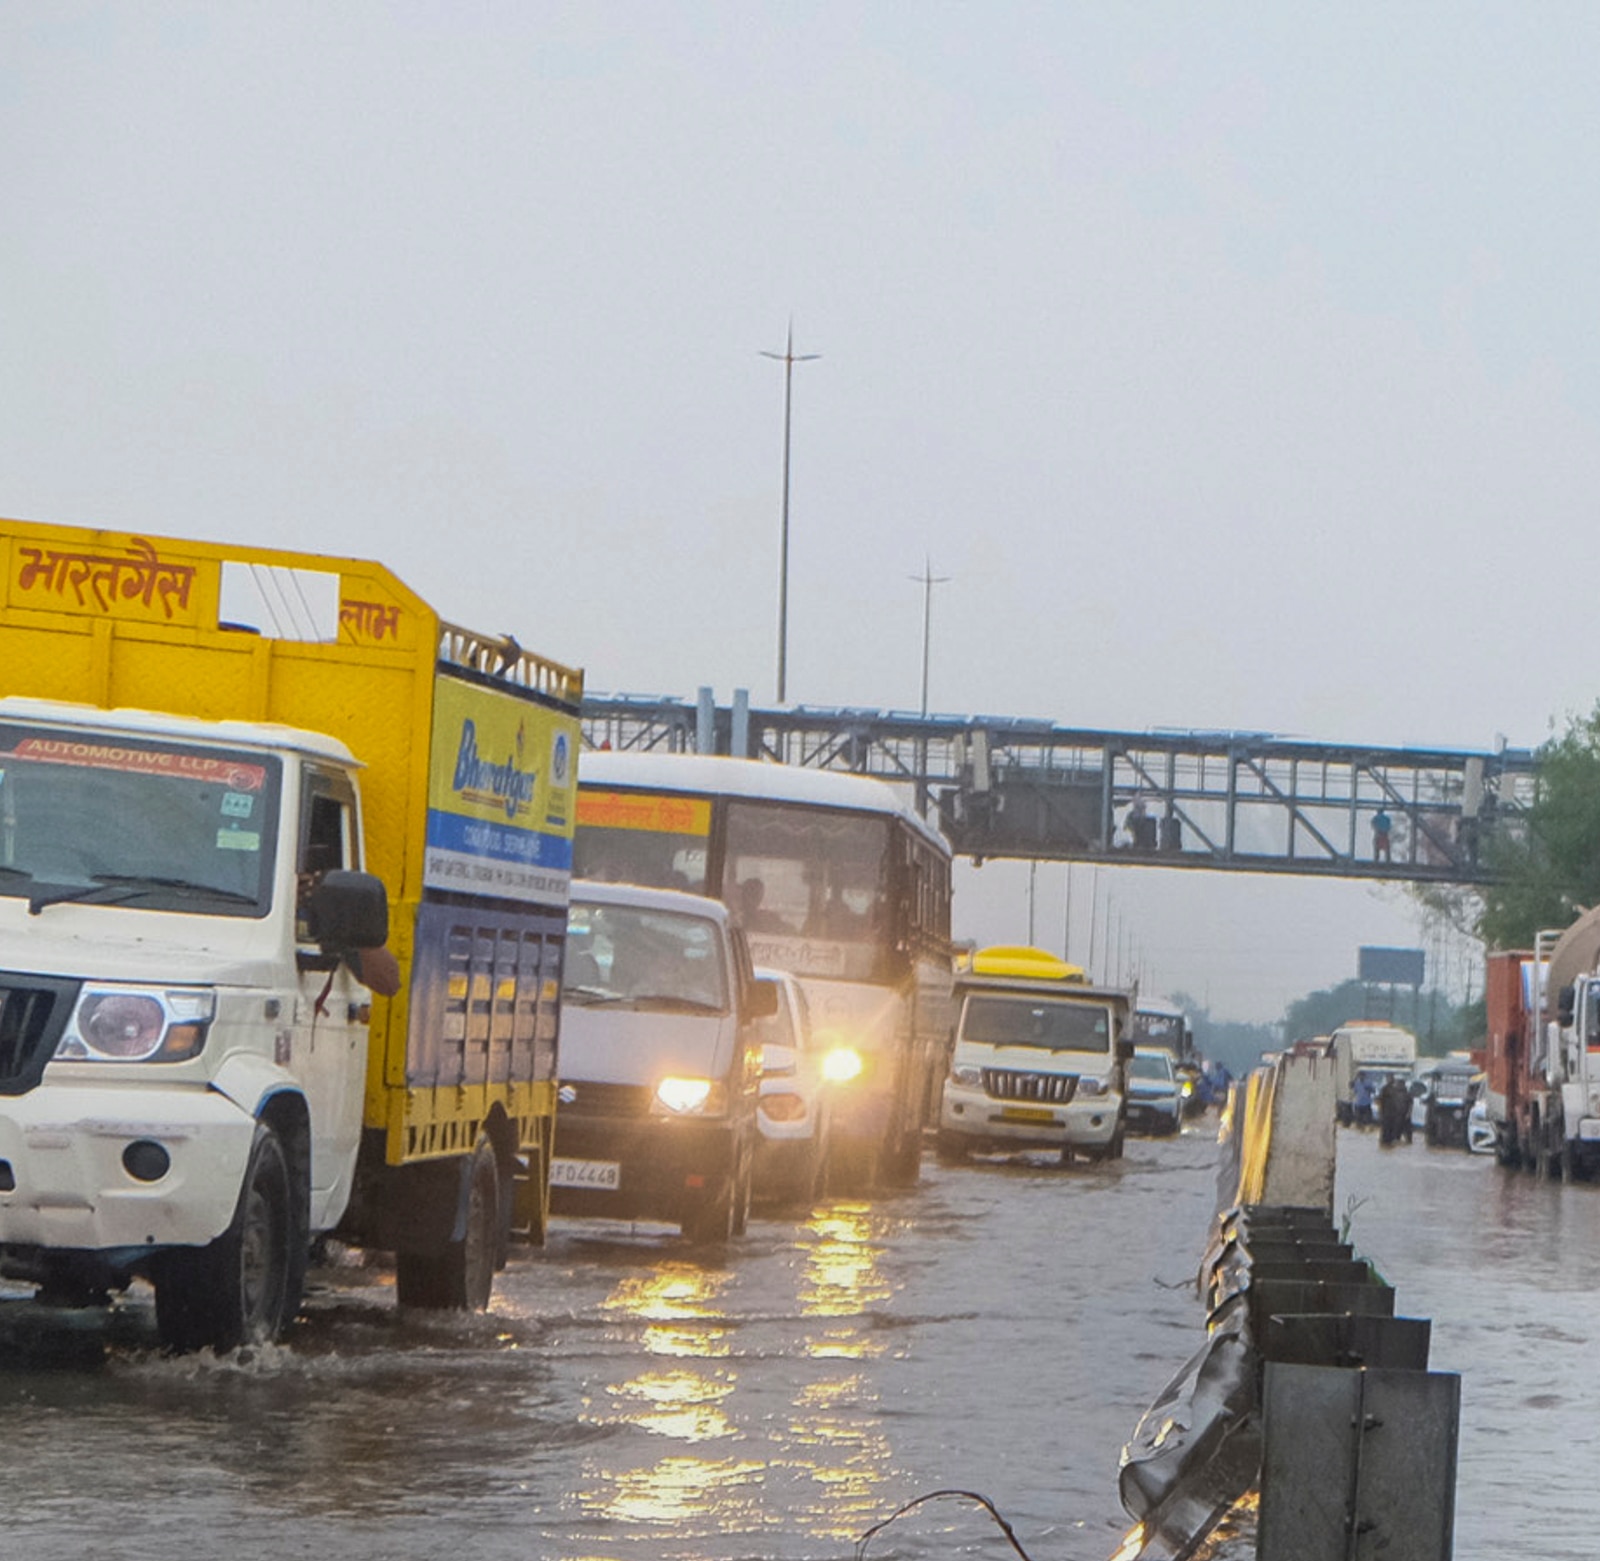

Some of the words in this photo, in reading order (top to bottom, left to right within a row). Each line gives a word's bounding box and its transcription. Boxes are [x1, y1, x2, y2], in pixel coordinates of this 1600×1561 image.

[18, 538, 196, 620] भारतगैस
[339, 599, 403, 641] लाभ
[27, 738, 173, 767] AUTOMOTIVE
[180, 756, 219, 771] LLP
